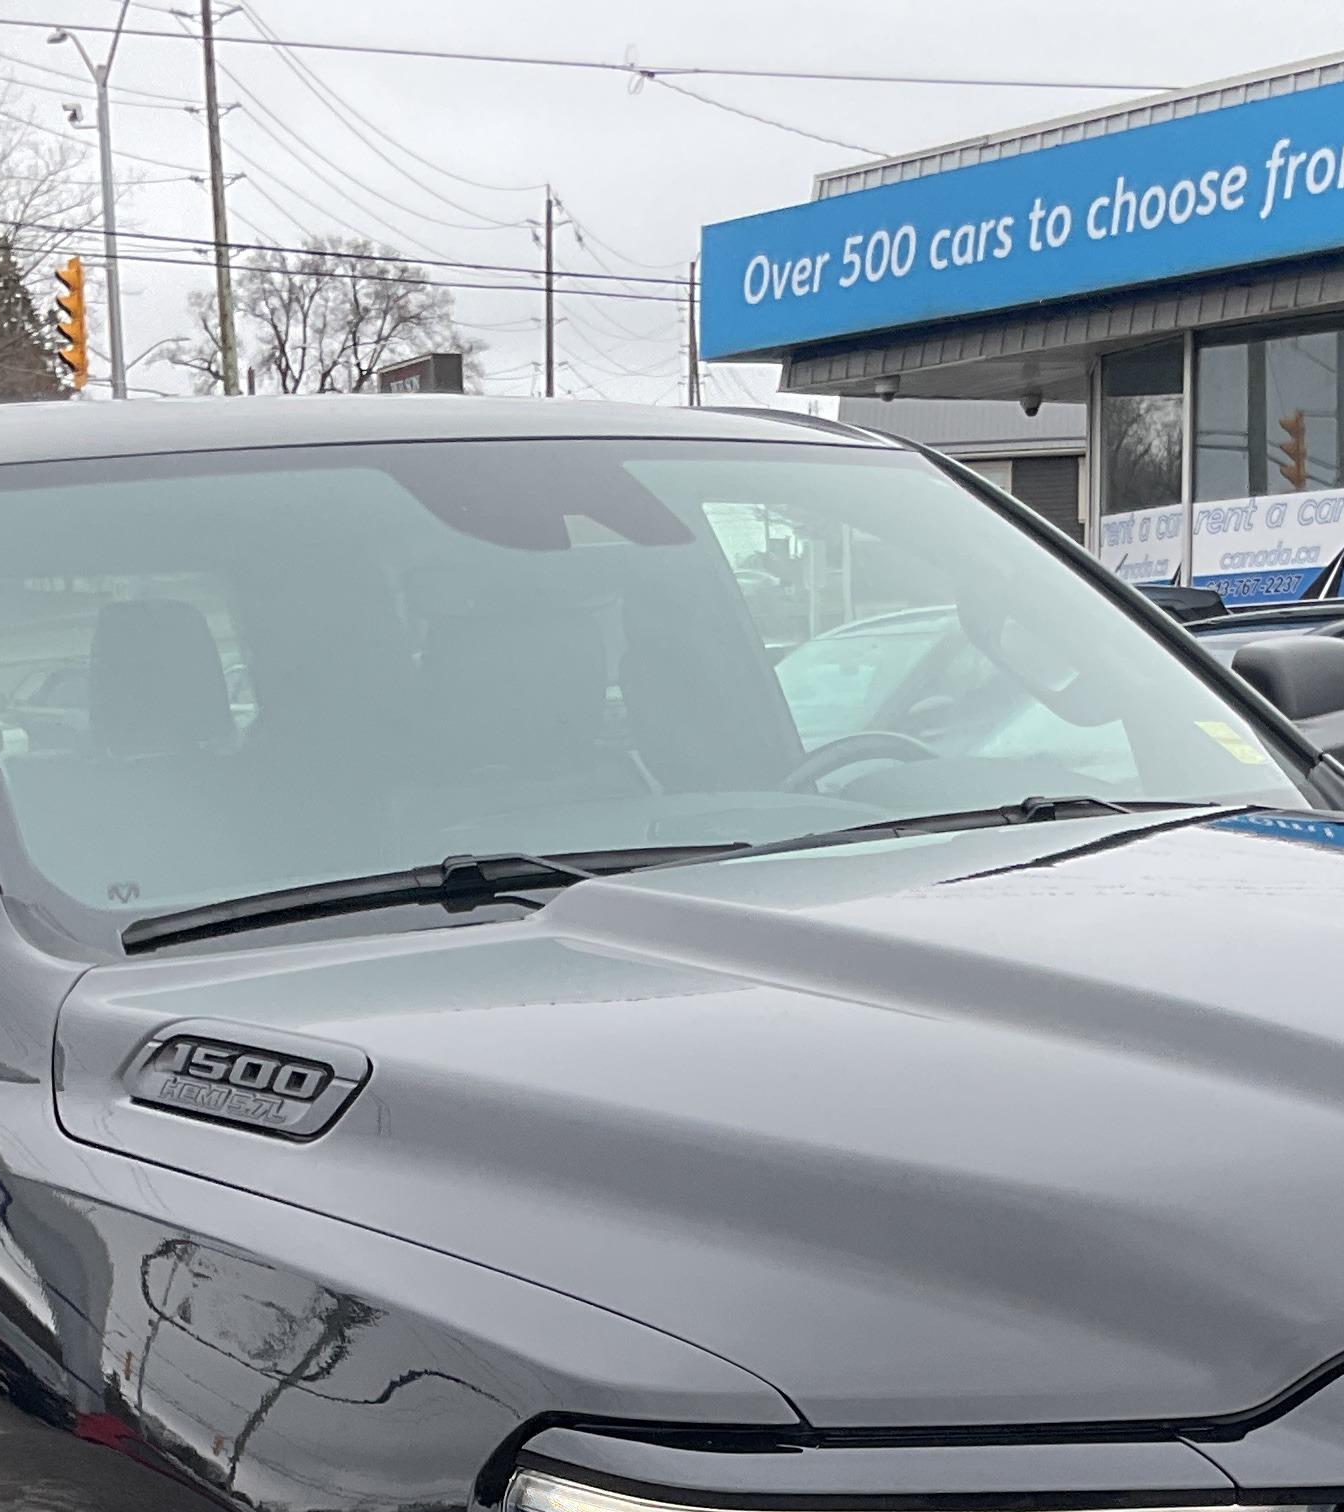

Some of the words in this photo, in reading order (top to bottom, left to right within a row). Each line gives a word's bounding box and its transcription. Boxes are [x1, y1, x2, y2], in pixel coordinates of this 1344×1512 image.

[743, 254, 830, 305] Over
[838, 225, 917, 289] 500
[929, 215, 1015, 271] cars
[1028, 197, 1072, 251] to
[1086, 164, 1248, 241] choose
[1100, 512, 1136, 549] rent
[1138, 516, 1152, 543] a
[1193, 503, 1258, 536] rent
[1265, 502, 1288, 529] a
[1218, 541, 1322, 571] canada.ca
[153, 1042, 323, 1099] 1500
